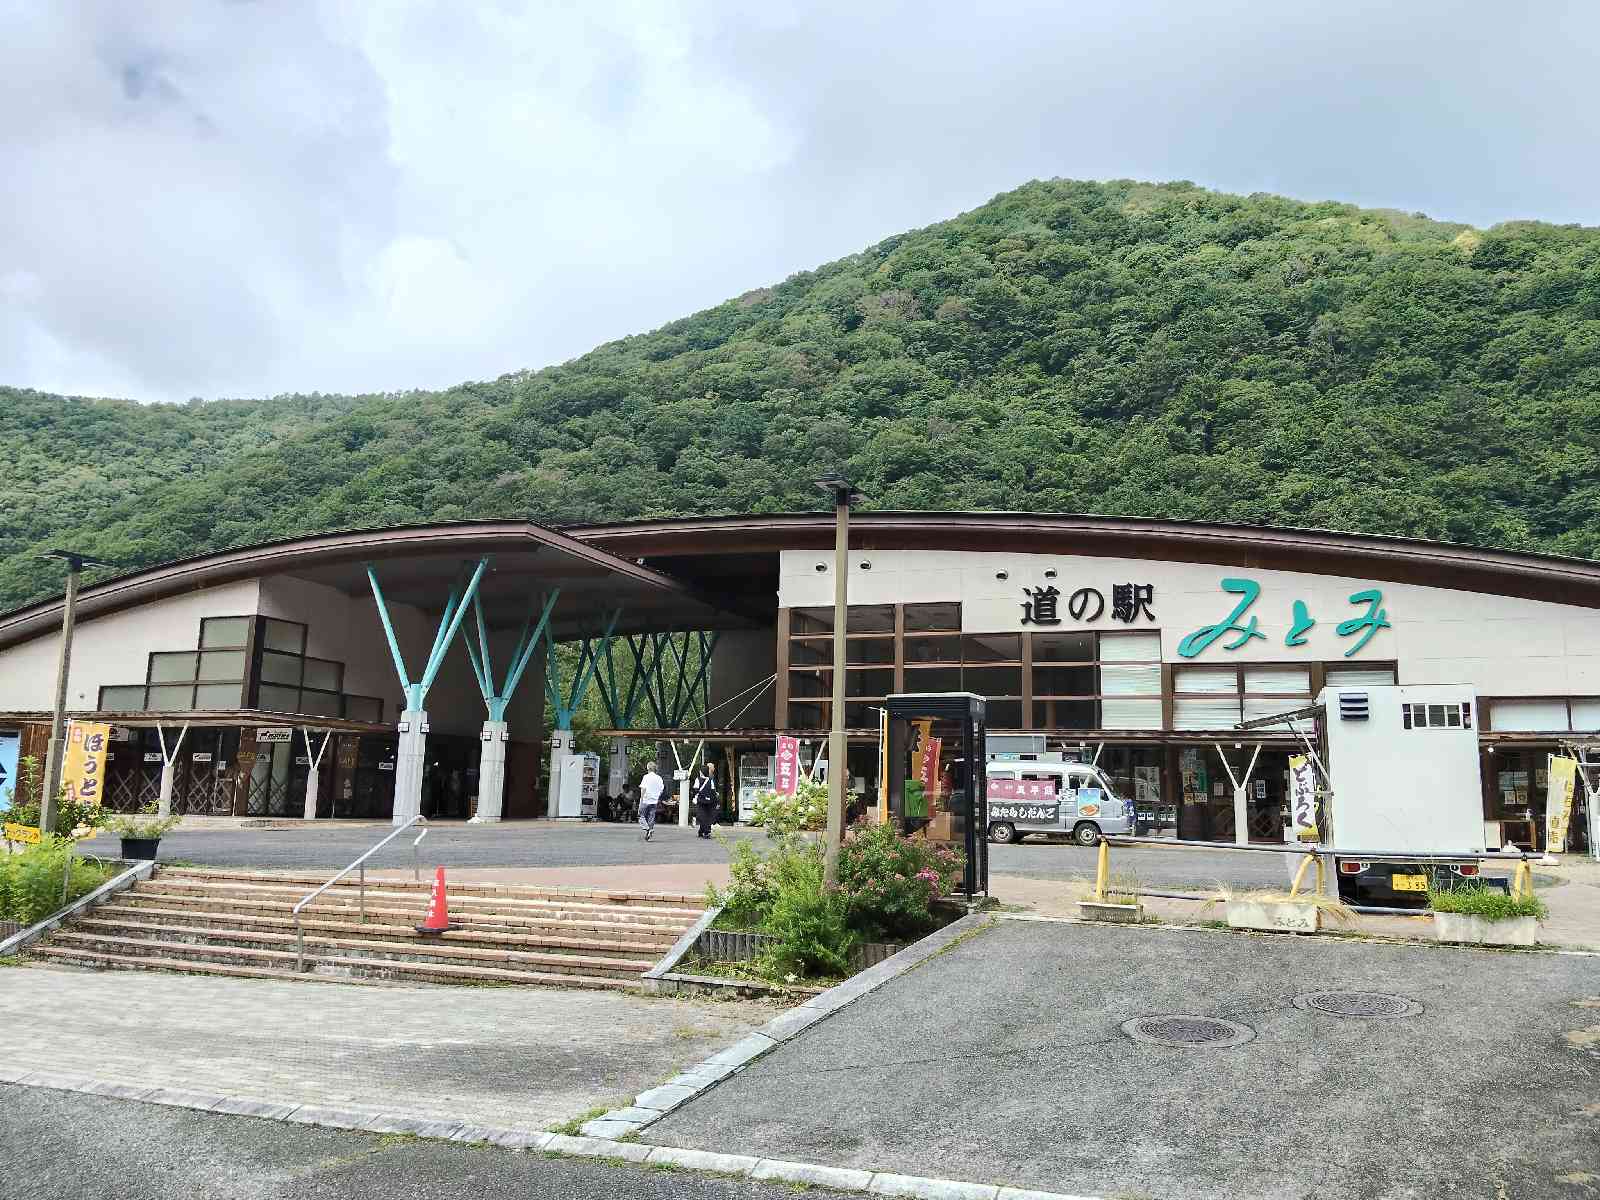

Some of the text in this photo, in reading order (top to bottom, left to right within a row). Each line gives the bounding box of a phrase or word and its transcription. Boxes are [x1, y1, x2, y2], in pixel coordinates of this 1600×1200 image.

[1019, 577, 1393, 658] 道の駅 みとみ
